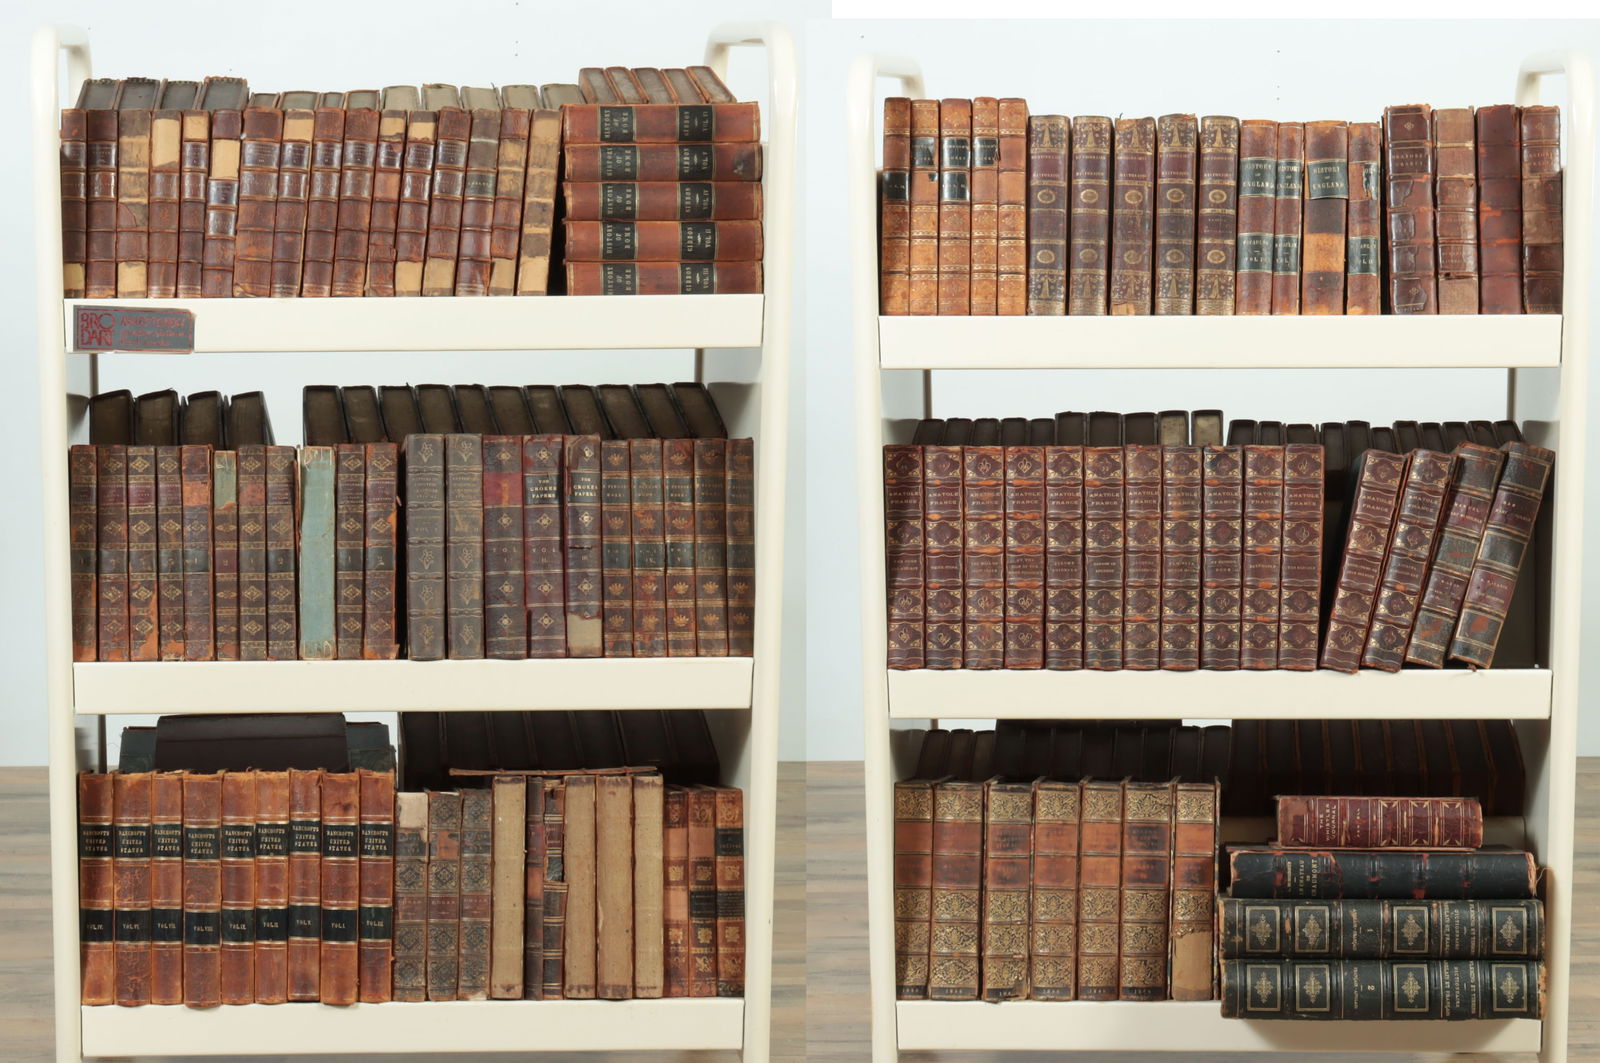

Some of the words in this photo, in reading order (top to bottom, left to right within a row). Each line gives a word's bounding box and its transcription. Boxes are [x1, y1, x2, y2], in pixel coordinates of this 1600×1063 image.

[1312, 166, 1340, 174] HISTORY
[1242, 181, 1275, 189] ENGLAND
[1312, 182, 1345, 190] ENGLAND
[80, 312, 116, 329] BRO
[80, 329, 115, 346] DART
